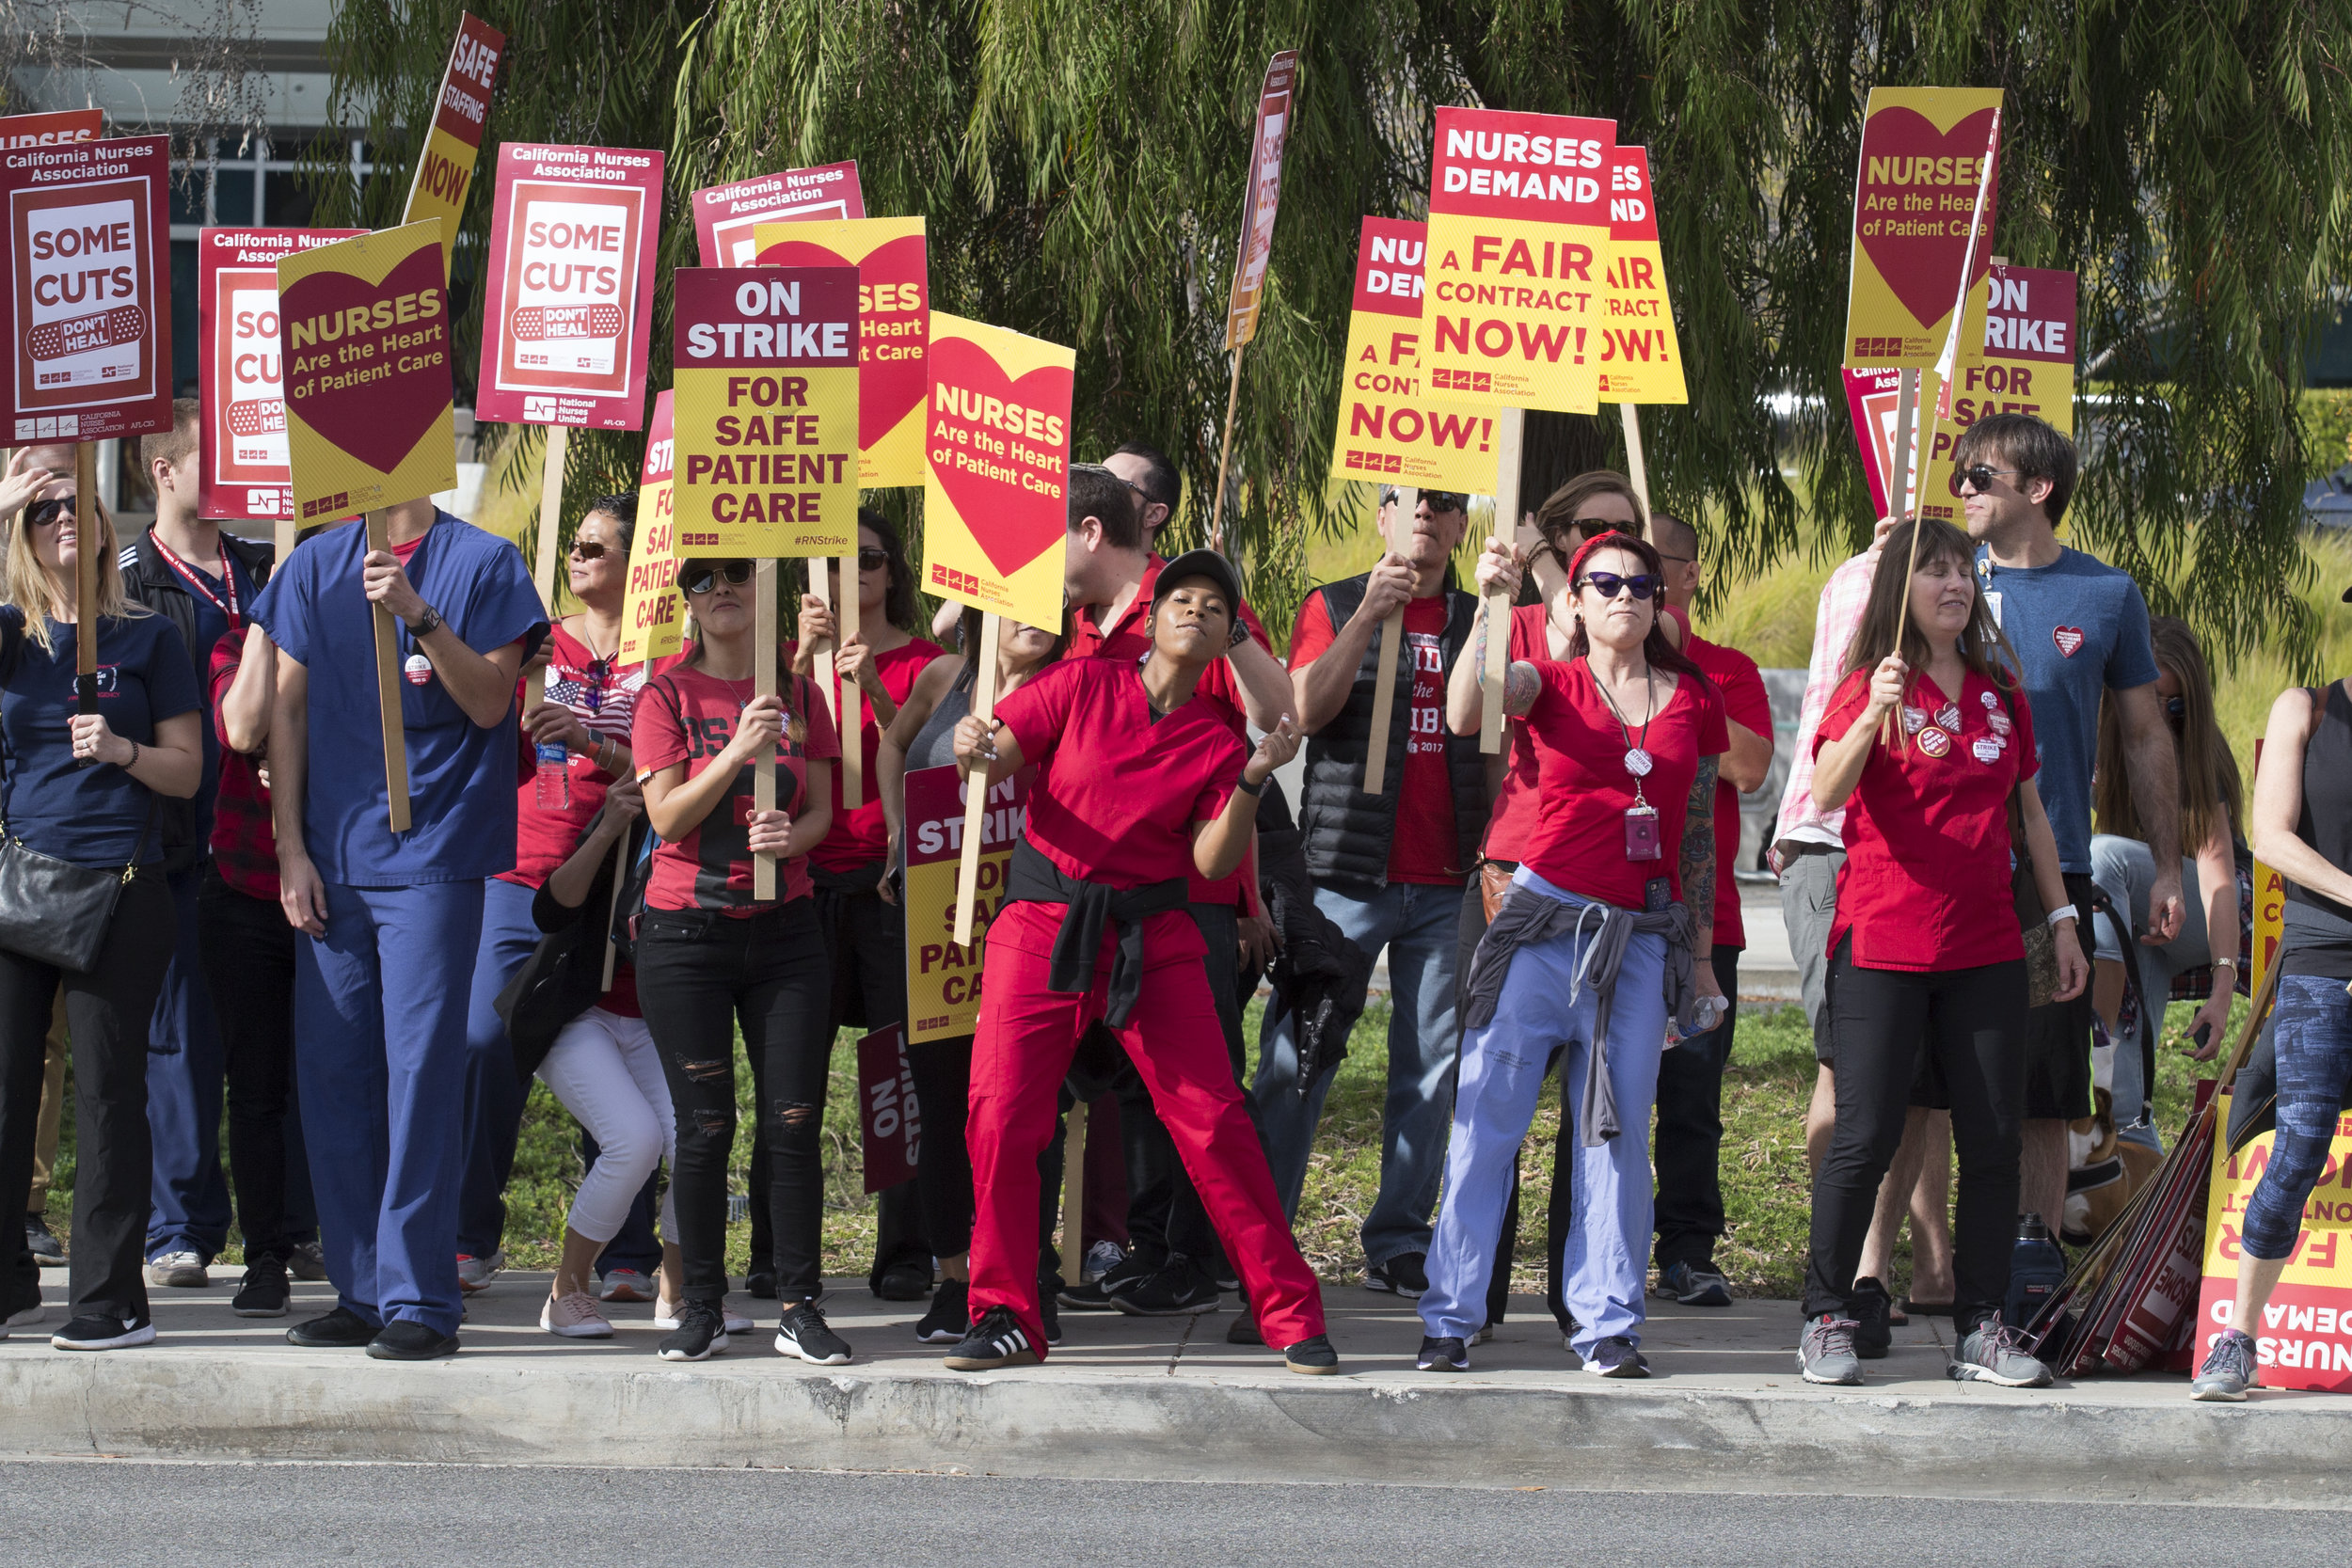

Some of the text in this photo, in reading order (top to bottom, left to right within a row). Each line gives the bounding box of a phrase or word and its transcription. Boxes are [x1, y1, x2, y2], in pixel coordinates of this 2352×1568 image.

[453, 33, 498, 89] SAFE
[443, 84, 485, 123] STAFFING
[6, 144, 153, 168] California Nurses
[512, 147, 651, 167] California Nurses
[1446, 129, 1602, 169] NURSES
[31, 163, 129, 182] Association
[420, 150, 469, 207] NOW
[532, 163, 626, 181] Association
[1443, 166, 1600, 203] DEMAND
[1867, 156, 1993, 185] NURSES
[706, 168, 844, 205] California Nurses
[730, 187, 823, 214] Association
[1864, 193, 1991, 213] Are the Heat
[33, 222, 132, 261] SOME
[214, 233, 293, 247] California
[527, 221, 621, 252] SOME
[1863, 219, 1988, 237] of Patient Cae
[1370, 236, 1427, 267] NU
[1439, 234, 1594, 281] A FAIR
[34, 265, 135, 308] CUTS
[524, 261, 617, 295] CUTS
[736, 281, 801, 317] ON
[1436, 281, 1592, 313] CONTRACT
[63, 314, 107, 338] DON'T
[291, 289, 441, 349] NURSES
[546, 307, 588, 323] DON'T
[546, 322, 588, 338] HEAL
[860, 318, 922, 338] Heart
[65, 329, 109, 353] HEAL
[293, 324, 442, 375] Are the Heart
[686, 323, 850, 358] STRIKE
[876, 344, 924, 361] Care
[1359, 344, 1378, 364] A
[1434, 315, 1587, 365] NOW!
[294, 351, 444, 399] of Patient Care
[1494, 373, 1530, 382] California
[1965, 364, 2033, 396] FOR
[559, 397, 596, 408] National
[728, 376, 809, 407] FOR
[1493, 388, 1535, 396] Association
[80, 410, 120, 420] CALIFORNIA
[558, 406, 589, 416] Nurses
[558, 415, 587, 424] United
[935, 382, 1064, 447] NURSES
[81, 423, 125, 435] ASSOCIATION
[715, 415, 820, 447] SAFE
[1350, 402, 1494, 452] NOW!
[933, 420, 1062, 474] Are the Heart
[1405, 456, 1438, 466] California
[687, 453, 850, 485] PATIENT
[932, 447, 1061, 499] of Patient Care
[1404, 469, 1442, 479] Association
[711, 493, 822, 524] CARE
[794, 535, 849, 546] #RNStrike
[636, 594, 677, 629] CARE
[1413, 681, 1435, 698] the
[1421, 741, 1443, 752] 2017
[1630, 751, 1650, 770] STRIKE
[2265, 873, 2283, 893] A
[870, 1077, 899, 1138] ON
[2153, 1263, 2191, 1306] SOME
